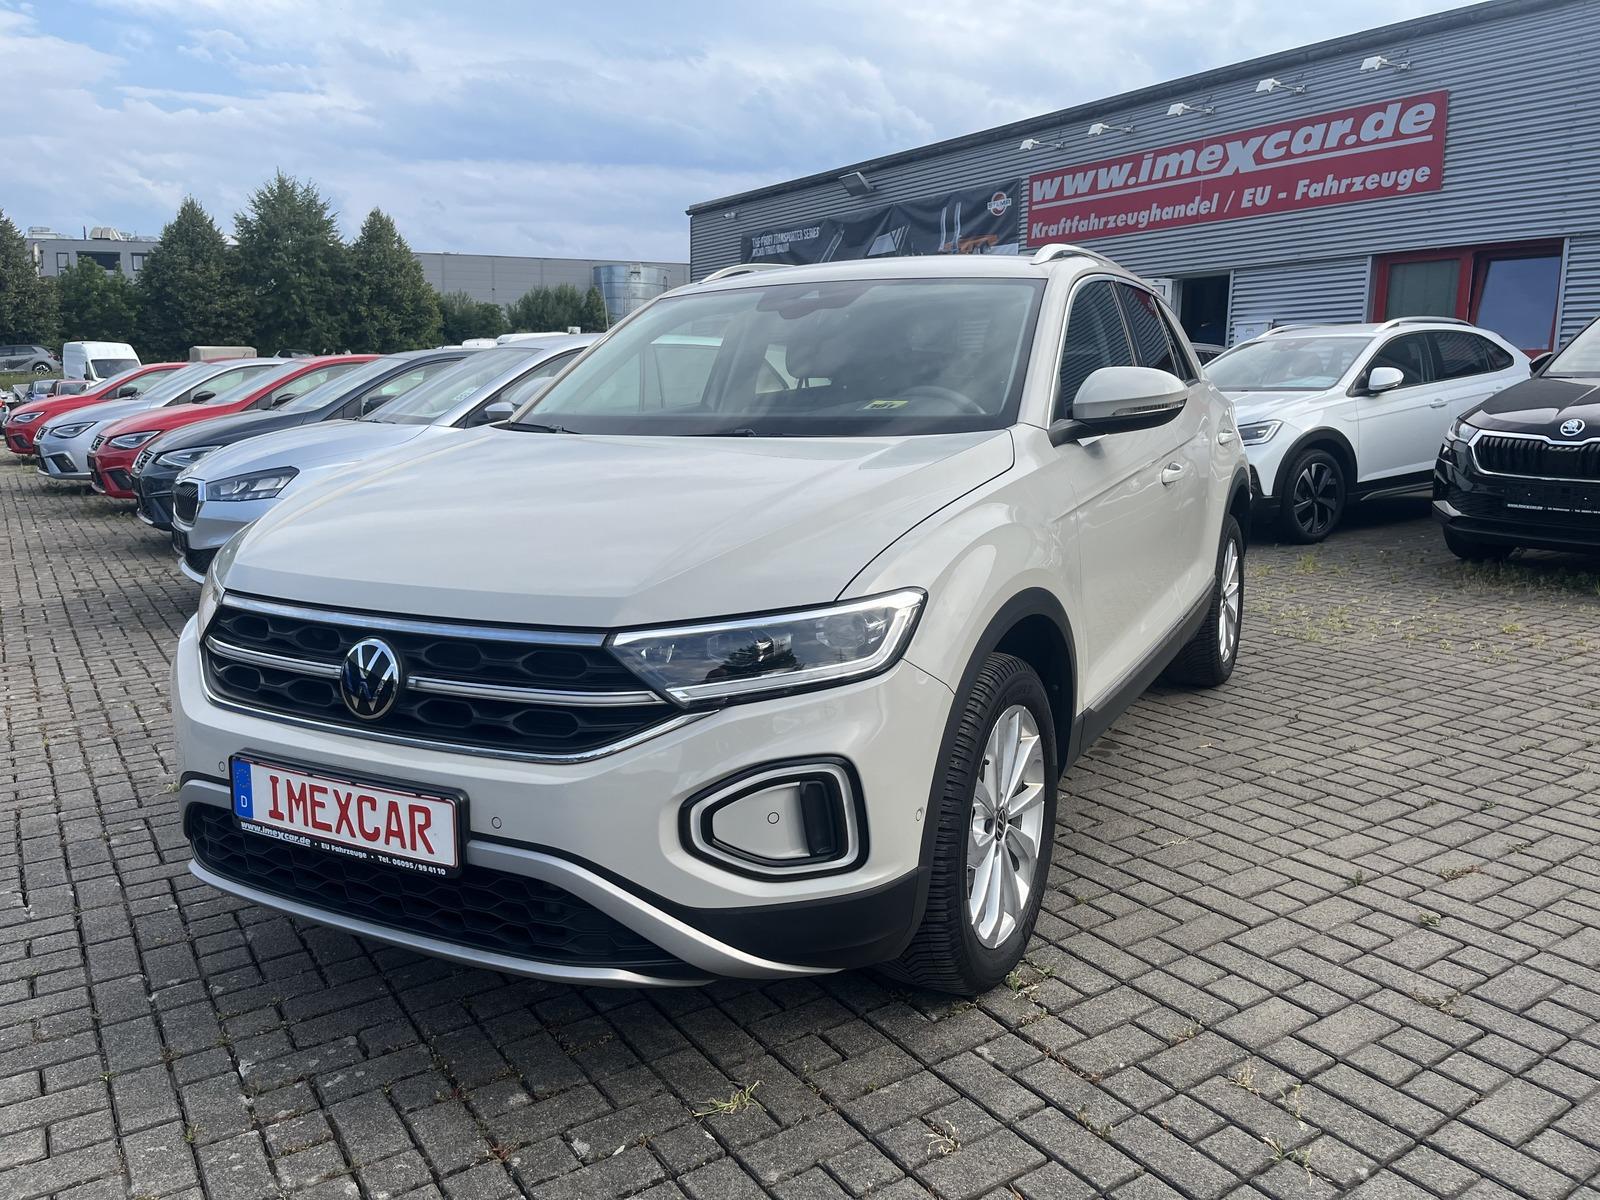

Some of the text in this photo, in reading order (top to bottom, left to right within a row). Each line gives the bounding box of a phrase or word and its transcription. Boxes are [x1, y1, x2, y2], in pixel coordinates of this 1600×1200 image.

[1032, 102, 1436, 202] www.imexcar.de
[1031, 193, 1219, 240] Kraftfahrzeughandel
[1241, 185, 1272, 209] EU
[1294, 165, 1431, 200] Fahrzeuge
[241, 795, 248, 808] D
[268, 775, 435, 855] IMEXCAR
[241, 821, 311, 846] www.imexcar.de
[321, 842, 330, 850] EU
[331, 845, 367, 859] Fahrzeuge
[378, 855, 391, 864] Tel.
